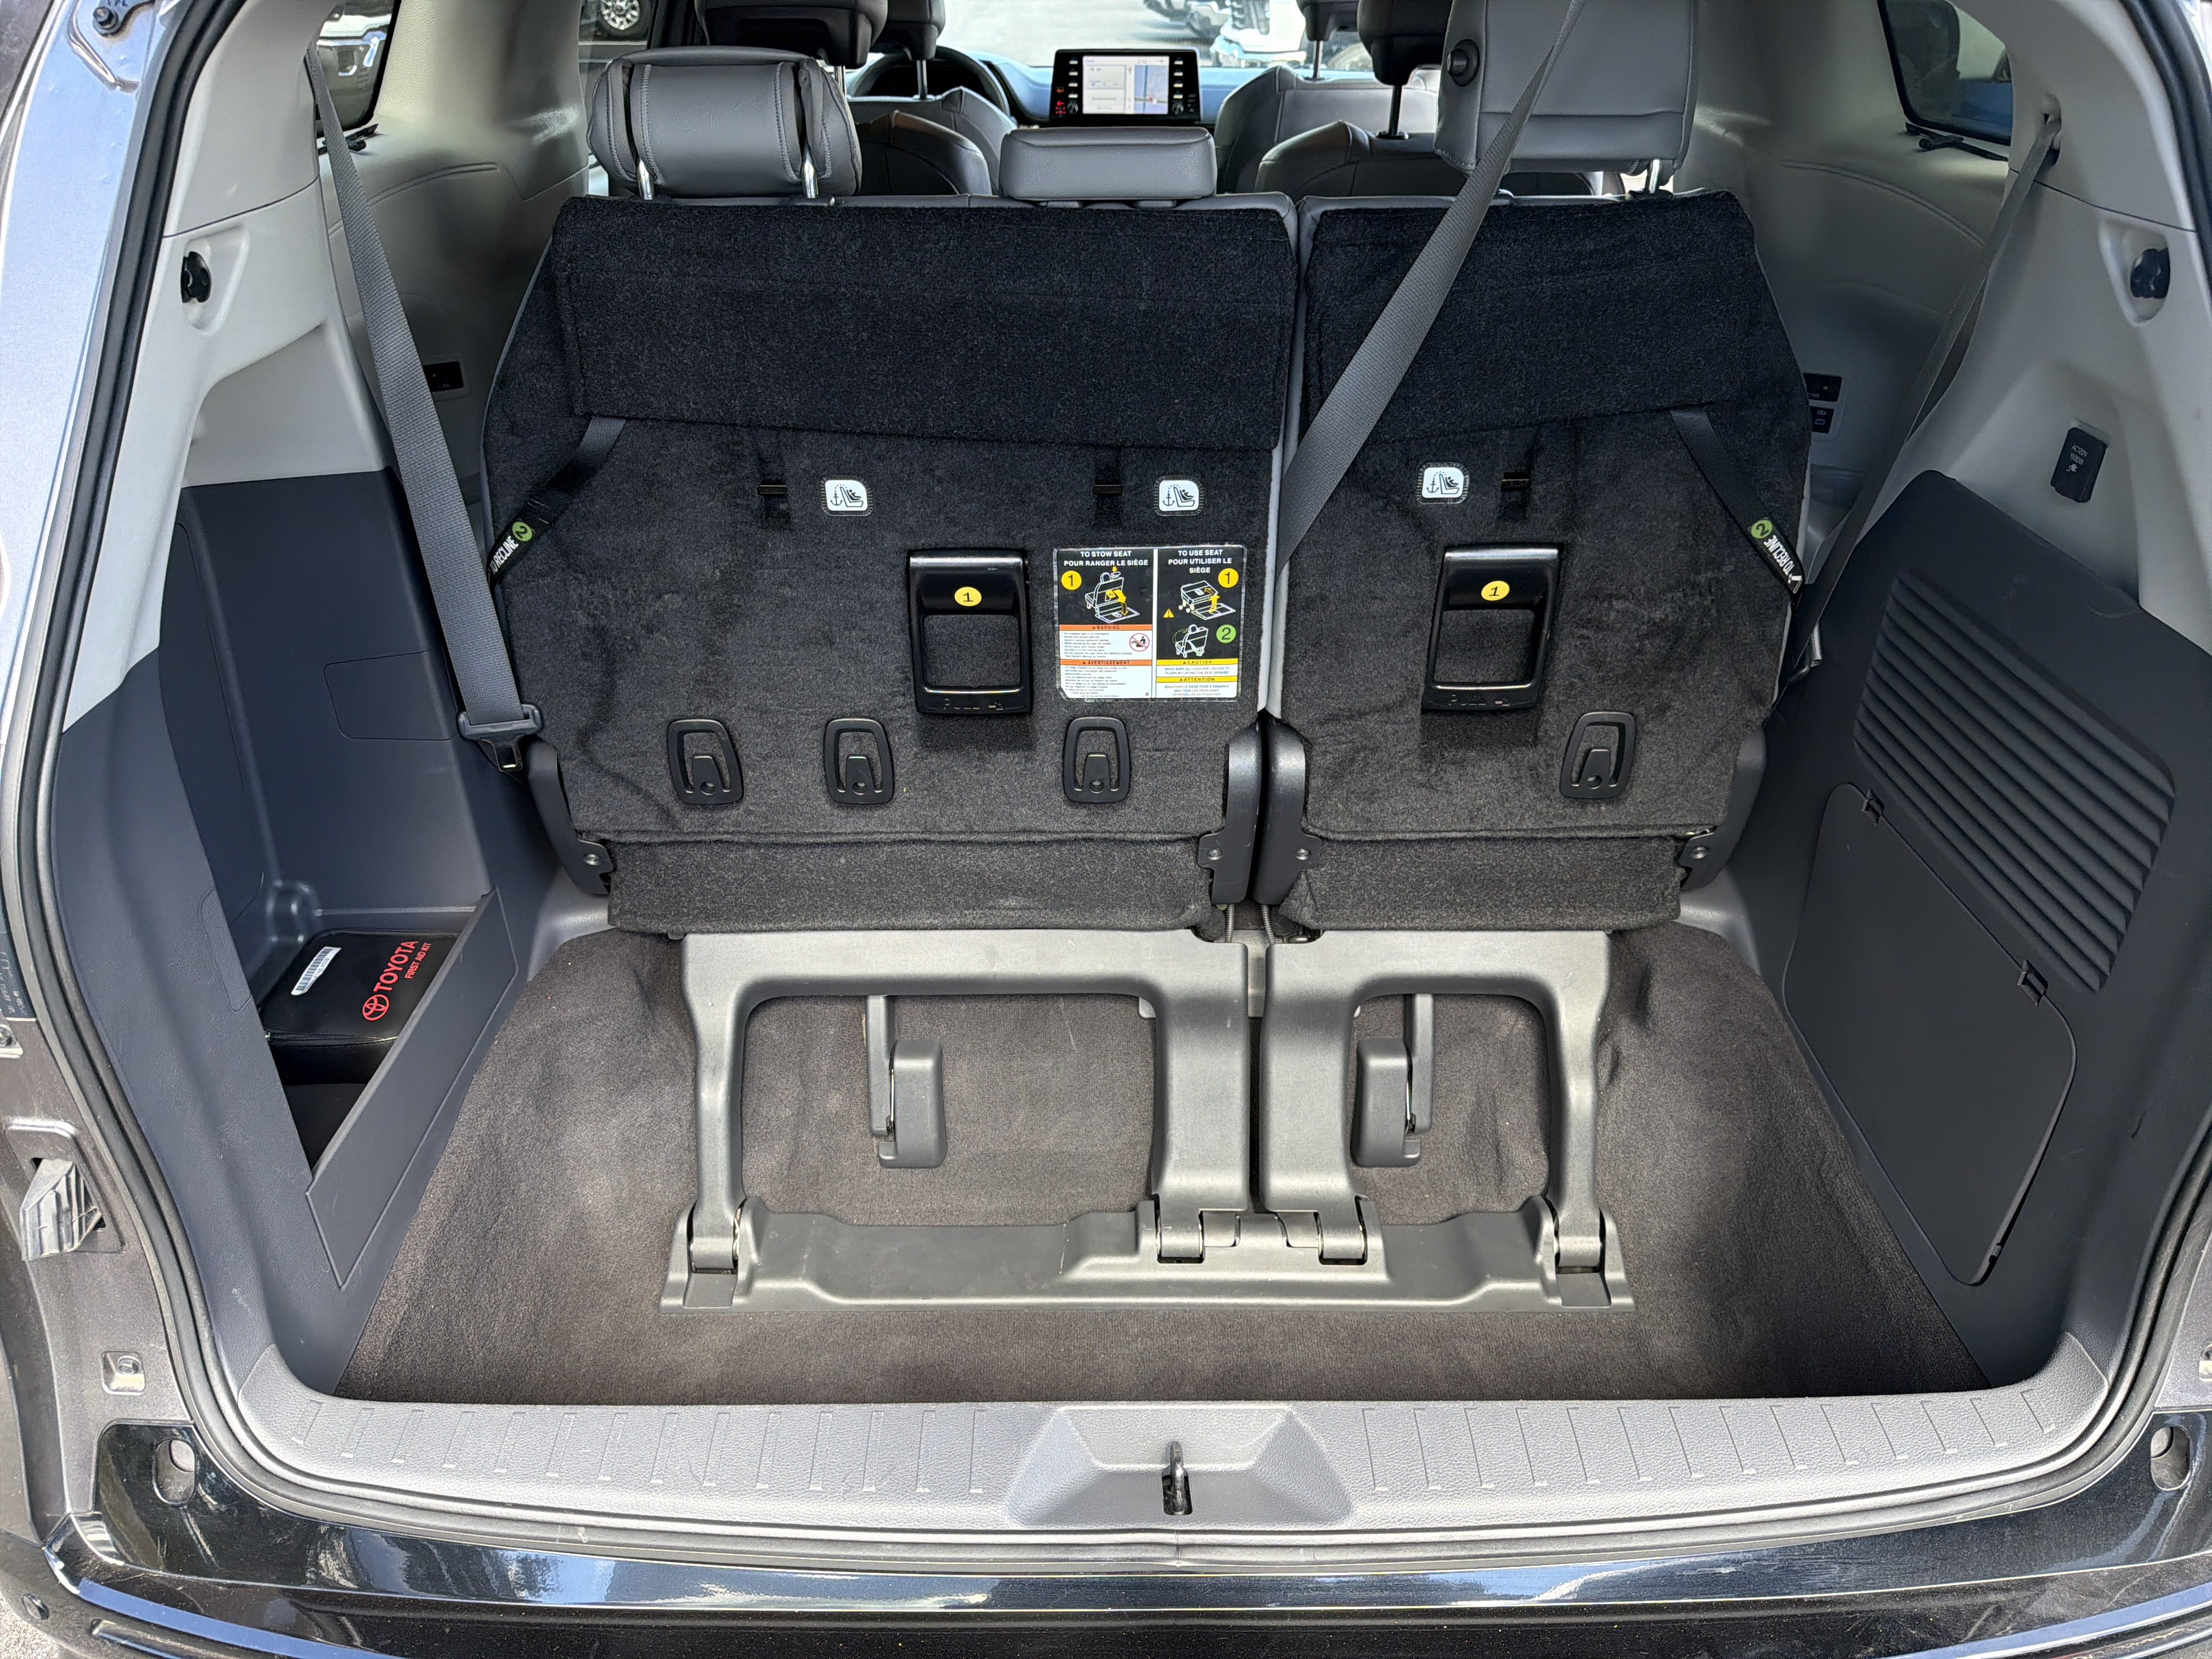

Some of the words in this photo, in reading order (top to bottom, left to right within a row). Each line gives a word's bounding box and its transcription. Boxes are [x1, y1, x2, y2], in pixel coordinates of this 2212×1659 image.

[2069, 453, 2084, 465] 1500W
[515, 526, 528, 539] 2
[1756, 523, 1769, 537] 2
[493, 535, 519, 568] RECLINE
[1763, 535, 1791, 567] RECLINE
[490, 560, 498, 574] TO
[1783, 560, 1795, 575] TO
[373, 941, 419, 992] TOYOTA
[404, 961, 420, 979] FIRST
[414, 951, 426, 962] AID
[420, 942, 432, 951] KIT
